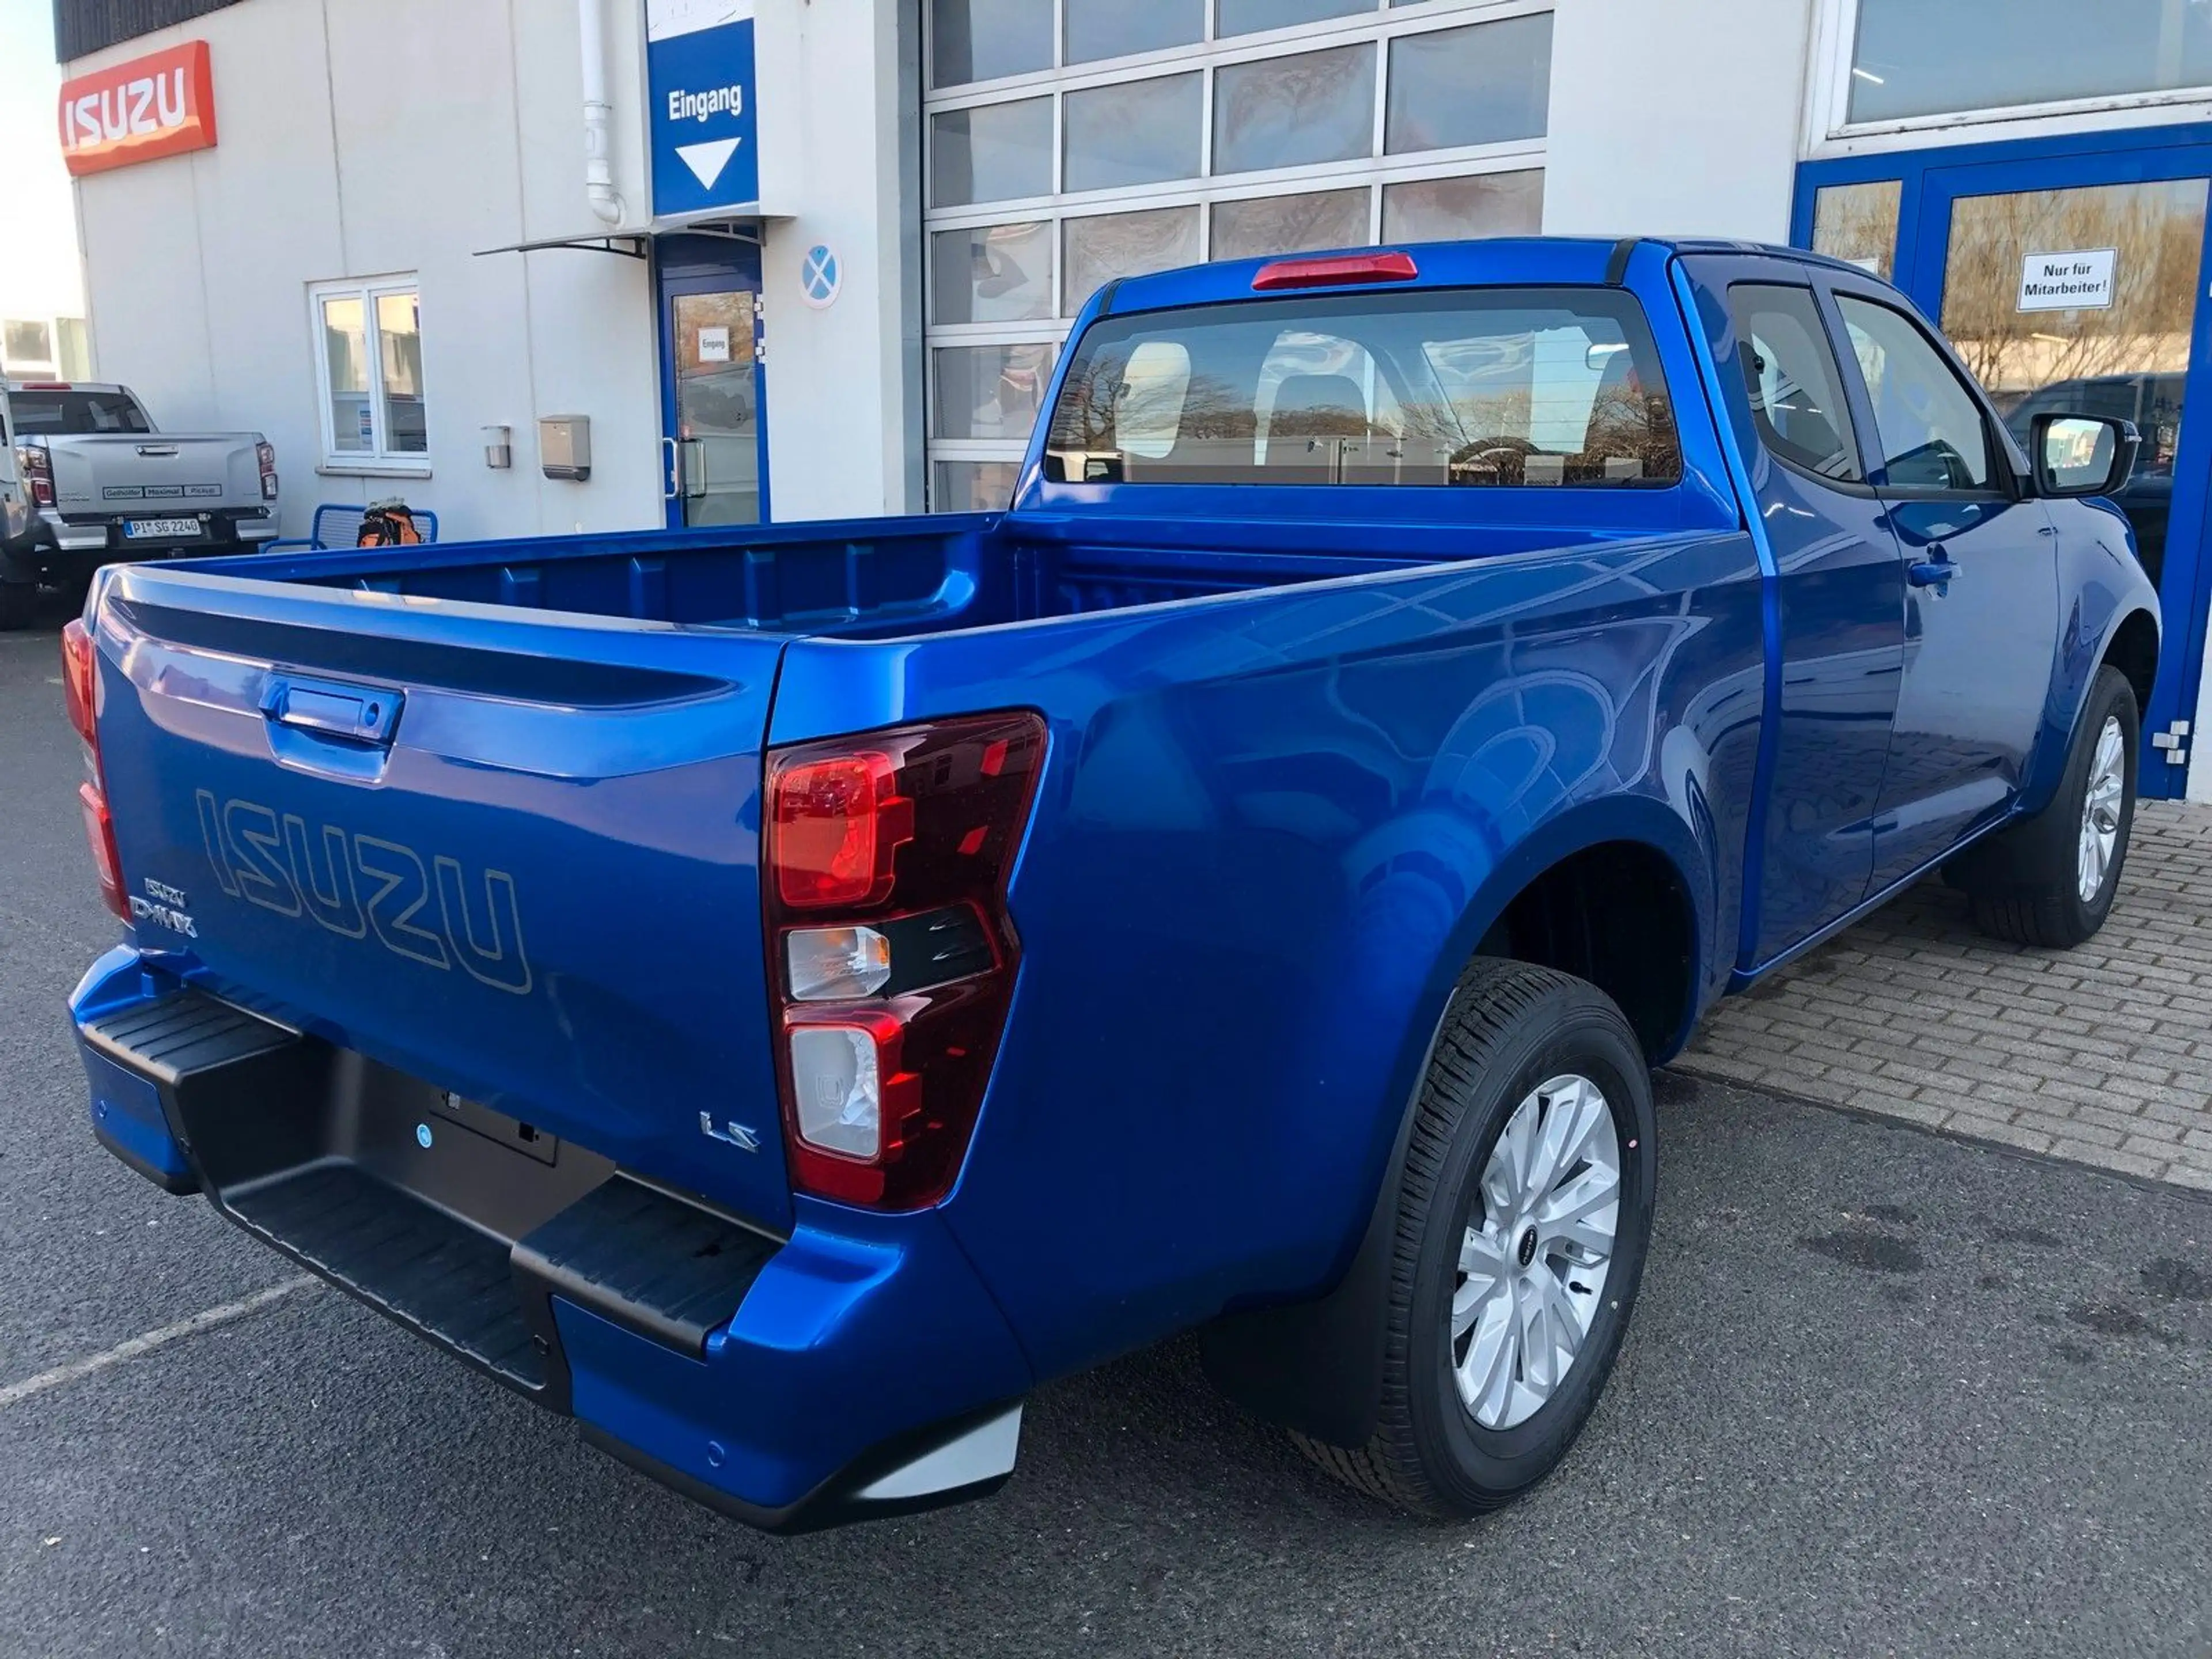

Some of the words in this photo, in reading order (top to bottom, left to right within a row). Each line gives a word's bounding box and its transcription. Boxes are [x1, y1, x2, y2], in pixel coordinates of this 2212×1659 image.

[66, 67, 186, 152] ISUZU
[668, 85, 742, 122] Eingang
[2043, 265, 2069, 276] Nur
[2073, 263, 2093, 275] für
[2024, 279, 2107, 296] Mitarbeiter!
[702, 338, 725, 350] Eingang
[133, 522, 146, 533] PI
[154, 522, 169, 533] SG
[172, 521, 197, 532] 2240
[196, 789, 532, 995] ISUZU
